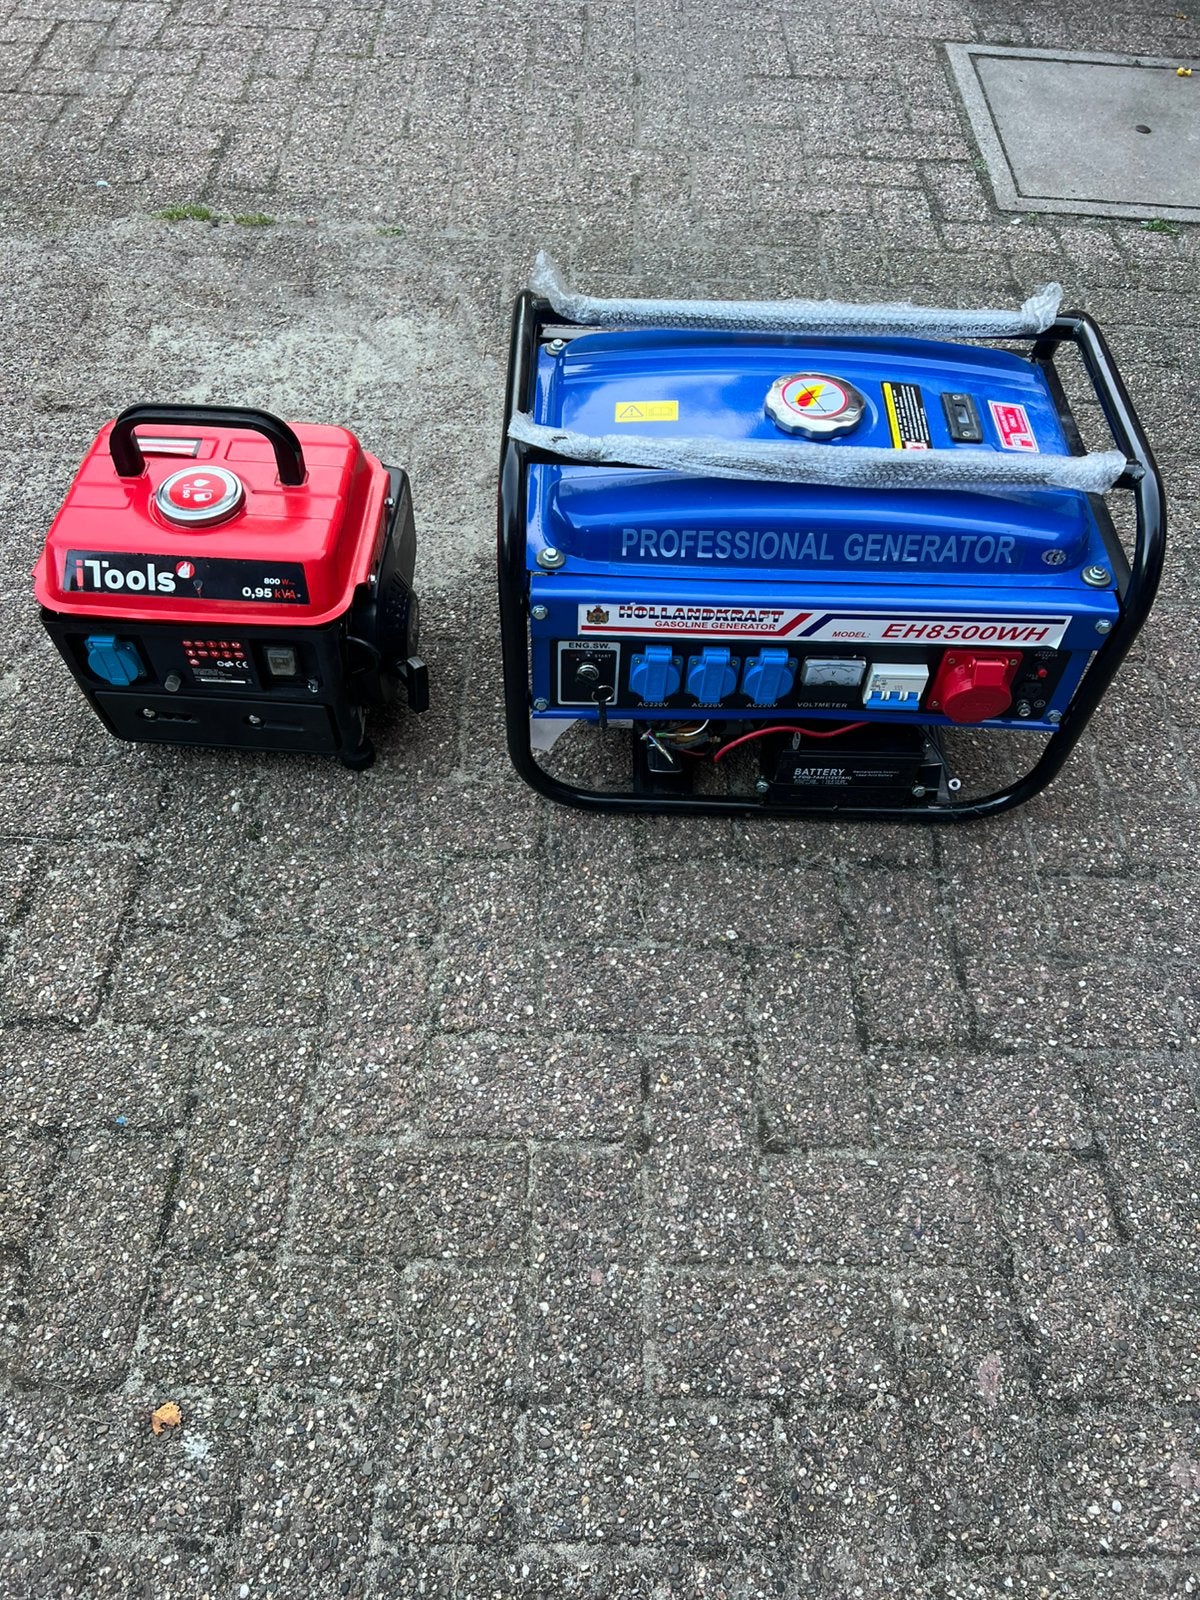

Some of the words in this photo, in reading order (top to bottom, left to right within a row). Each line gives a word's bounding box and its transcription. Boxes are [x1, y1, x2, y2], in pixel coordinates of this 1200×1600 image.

[621, 528, 835, 561] PROFESSIONAL
[843, 533, 1016, 564] GENERATOR
[76, 560, 176, 592] iTools
[263, 577, 281, 585] 800
[242, 586, 273, 599] 0,95
[274, 588, 297, 599] kVA
[618, 605, 785, 623] HOLLANDKRAFT
[654, 620, 709, 629] GASOLINE
[711, 621, 777, 631] GENERATOR
[831, 630, 871, 639] MODEL:
[881, 623, 1050, 641] EH8500WH
[794, 768, 845, 776] BATTERY
